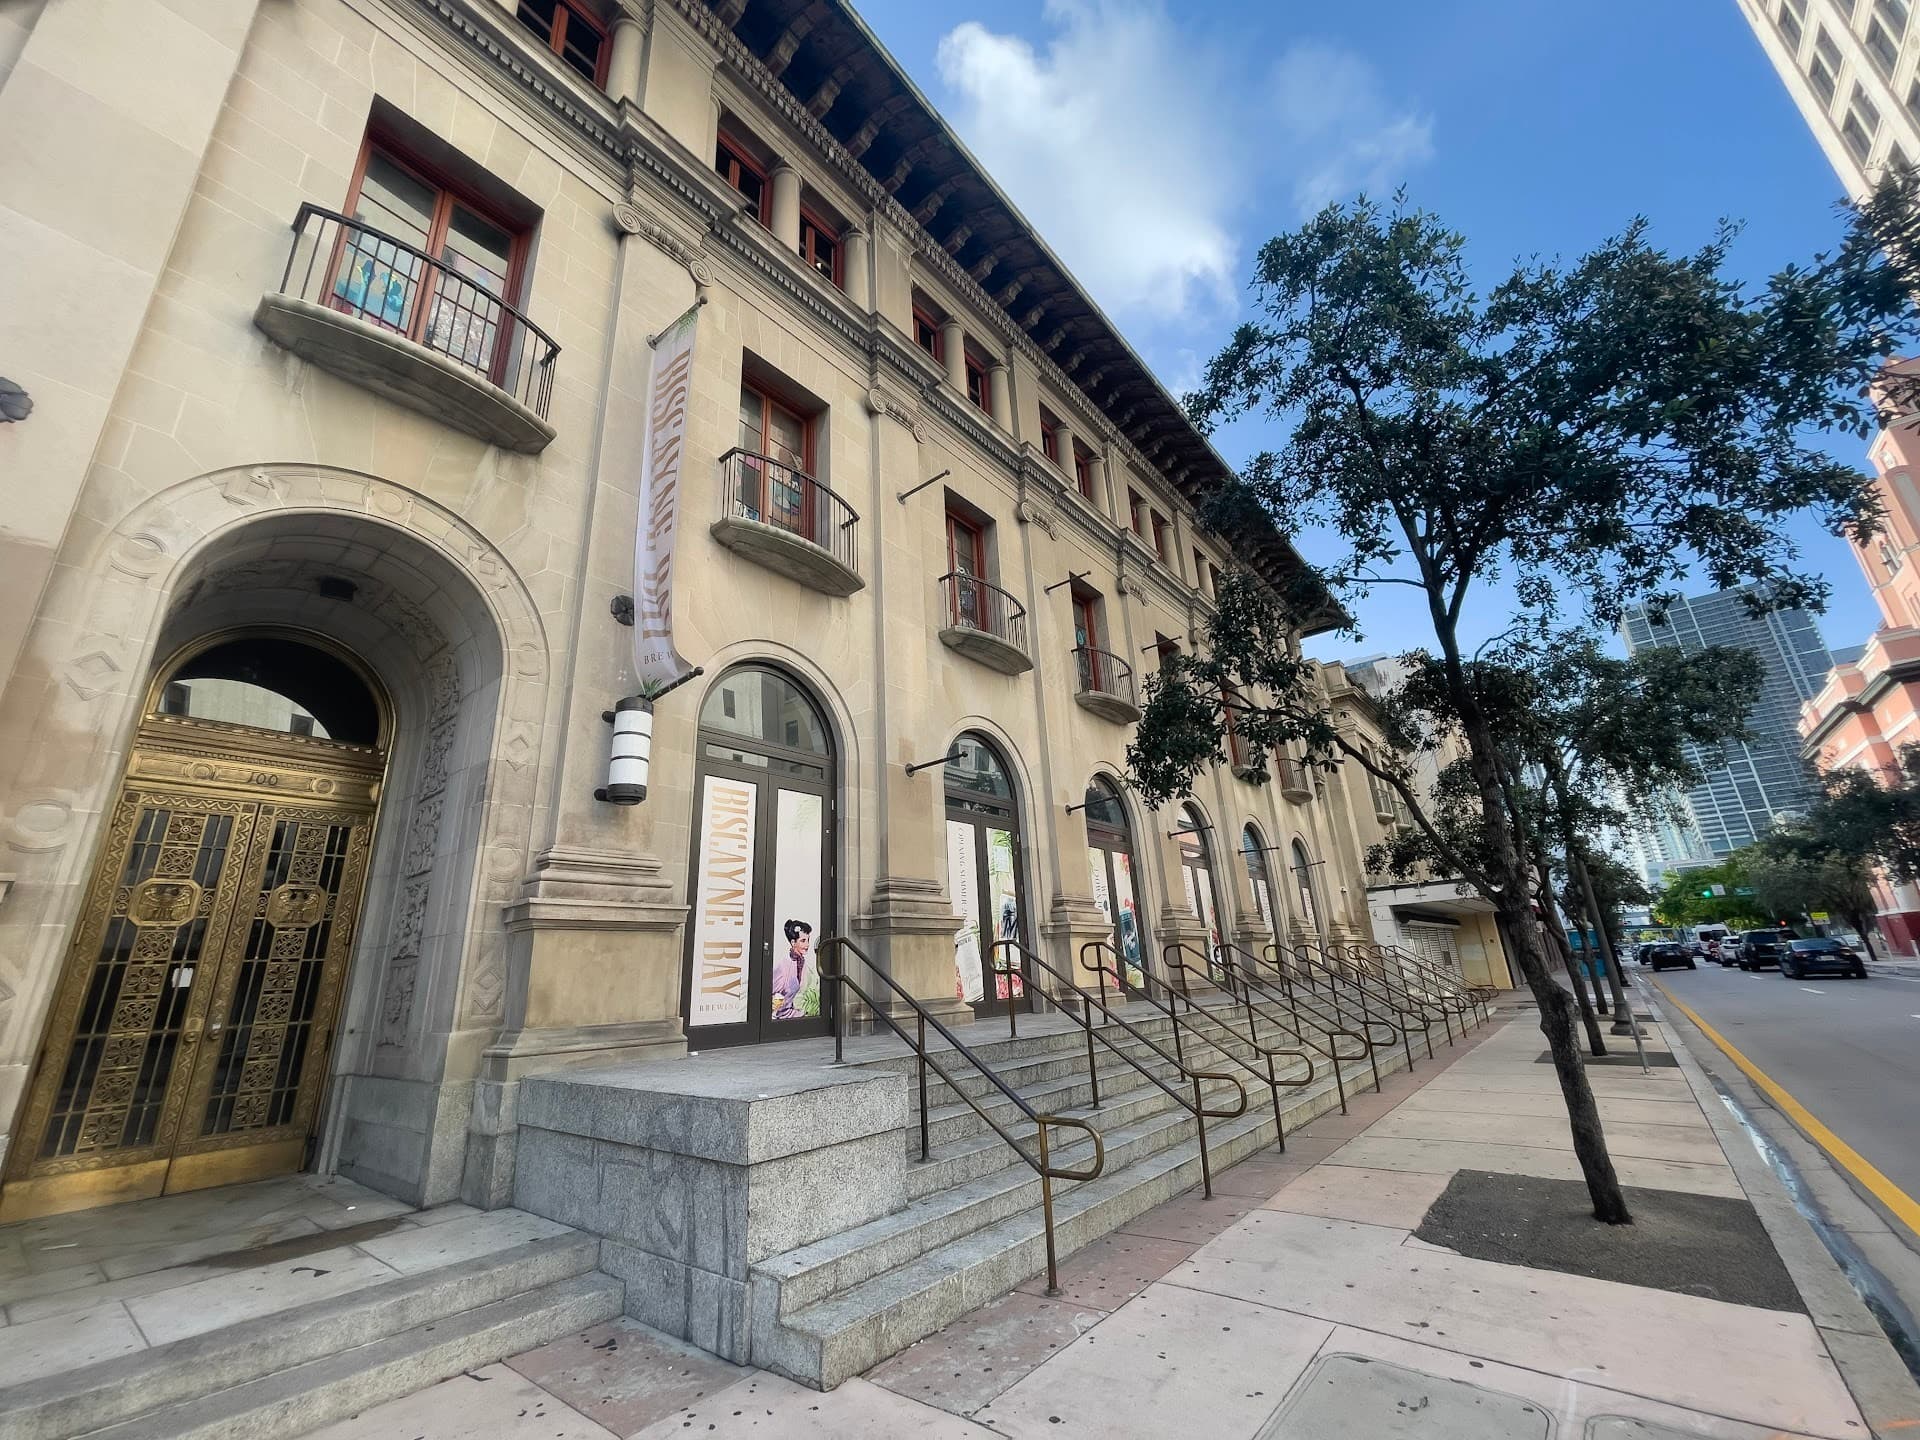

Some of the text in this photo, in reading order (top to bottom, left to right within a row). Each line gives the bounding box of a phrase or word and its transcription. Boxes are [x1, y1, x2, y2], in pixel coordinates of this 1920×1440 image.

[642, 348, 690, 640] BISCAYNE BAY
[247, 771, 278, 786] 100
[958, 827, 966, 867] OPENING
[700, 785, 750, 1001] BISCAYNE BAY
[959, 869, 968, 905] SUMMER
[699, 1003, 739, 1012] BREWING
